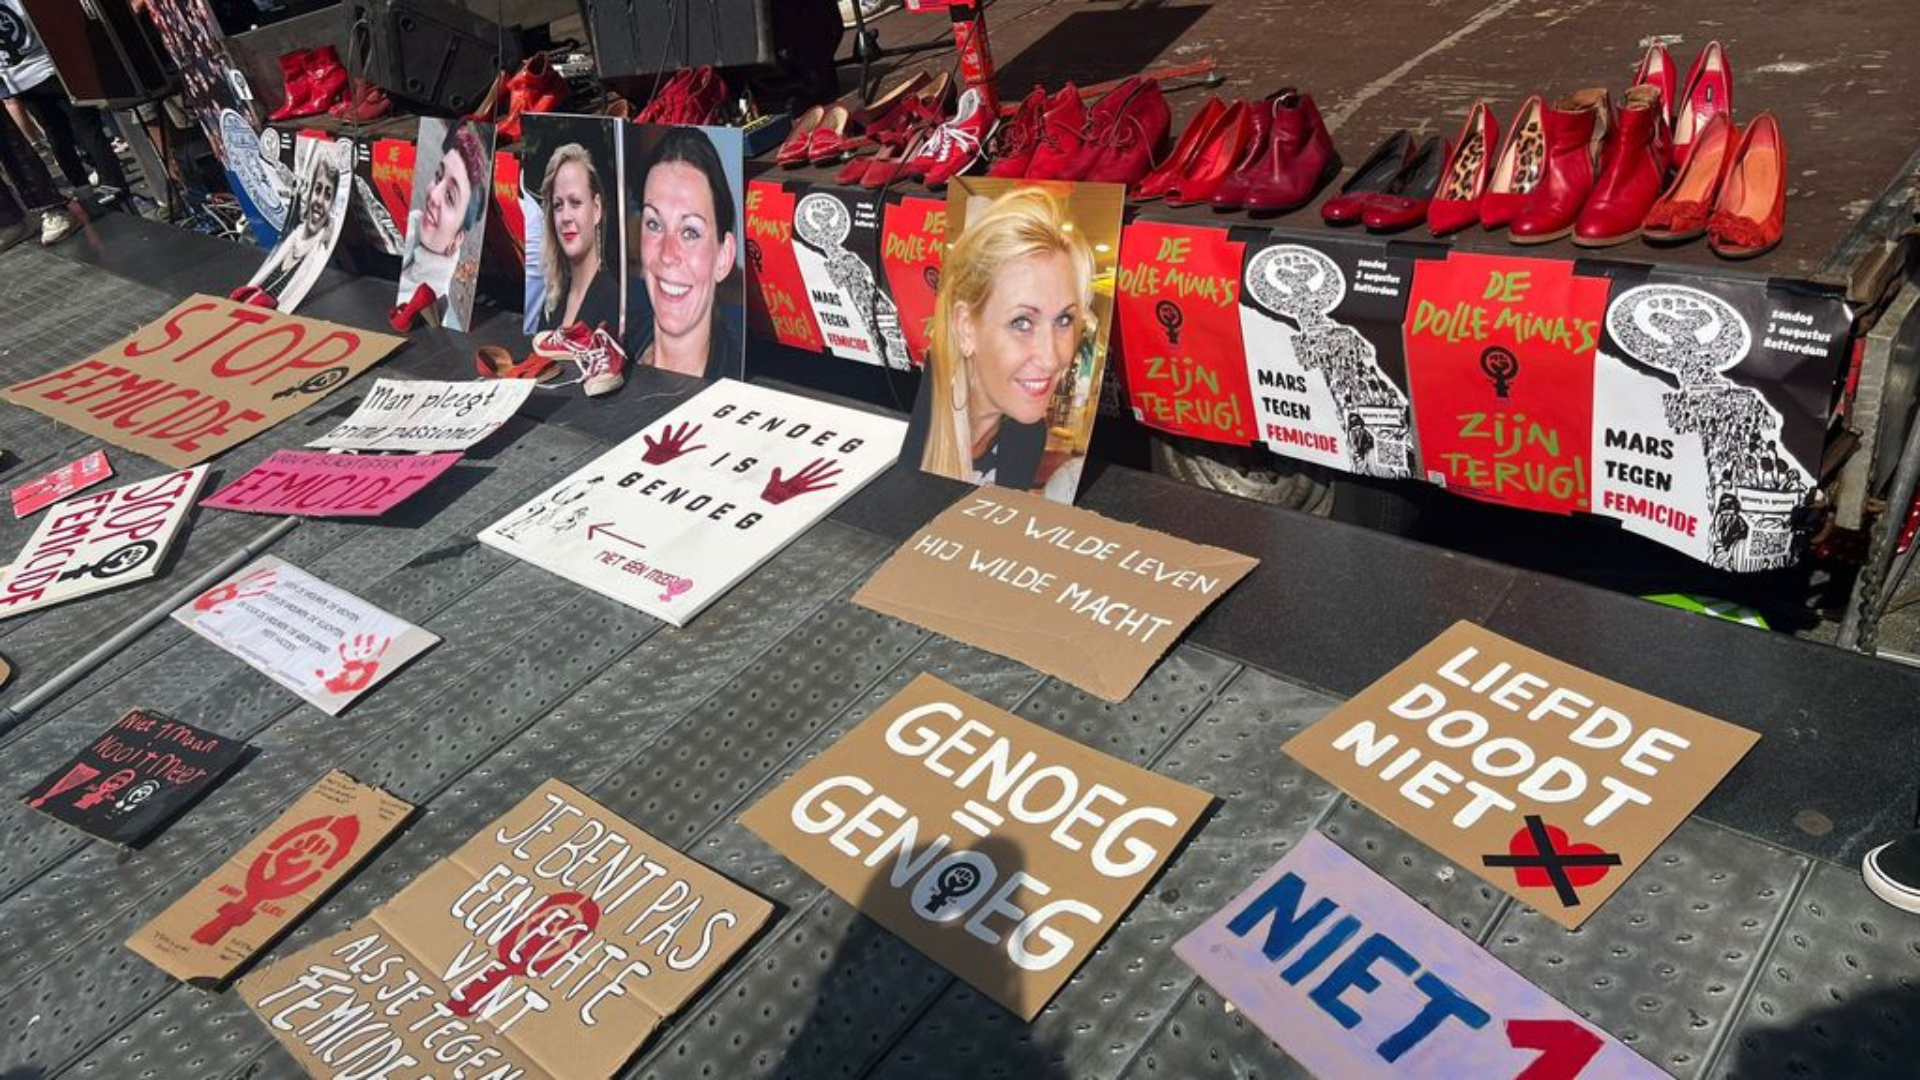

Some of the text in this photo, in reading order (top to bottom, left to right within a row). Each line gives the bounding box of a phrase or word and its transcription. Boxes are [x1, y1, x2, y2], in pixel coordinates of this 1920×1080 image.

[885, 232, 926, 264] DOLLE
[1156, 237, 1192, 263] DE
[811, 289, 843, 306] MARS
[1118, 262, 1160, 298] OLLE
[1483, 270, 1532, 302] DE
[819, 312, 850, 328] TEGEN
[1411, 299, 1489, 342] DOLLE
[1767, 323, 1832, 343] 3 augustus
[1771, 309, 1814, 326] zondag
[123, 303, 361, 387] STOP
[827, 333, 870, 353] FEMICIDE
[1763, 337, 1829, 358] Rotterdam
[364, 386, 415, 410] Man
[1257, 369, 1307, 393] MARS
[10, 360, 266, 453] FEMICIDE
[712, 404, 864, 454] GENOEG
[1136, 391, 1245, 437] TERUG!
[1261, 397, 1311, 421] TEGEN
[1266, 423, 1339, 454] FEMICIDE
[1604, 428, 1675, 460] MARS
[710, 452, 758, 473] IS
[1441, 452, 1588, 508] TERUG!
[1604, 460, 1673, 492] TEGEN
[89, 470, 194, 544] STOP
[207, 468, 425, 510] FEMICIDE
[617, 472, 763, 530] GENOEG
[1602, 490, 1698, 538] FEMICIDE
[961, 498, 1220, 594] ZIJ WILDE LEVEN
[913, 534, 1172, 643] HIJ WILDE MACHT
[1437, 646, 1691, 776] LIEFDE
[1331, 720, 1517, 829] NIET
[1387, 682, 1653, 827] DOODT
[885, 702, 1178, 877] GENOEG
[496, 793, 738, 971] JE BENT PAS
[790, 775, 1103, 970] GENOEG
[450, 863, 652, 1026] EEN ECHTE
[1225, 871, 1492, 1064] NIET
[333, 934, 525, 1080] ALS JE TEGEN
[441, 940, 551, 1036] VENT
[257, 964, 420, 1080] FEMICIDE
